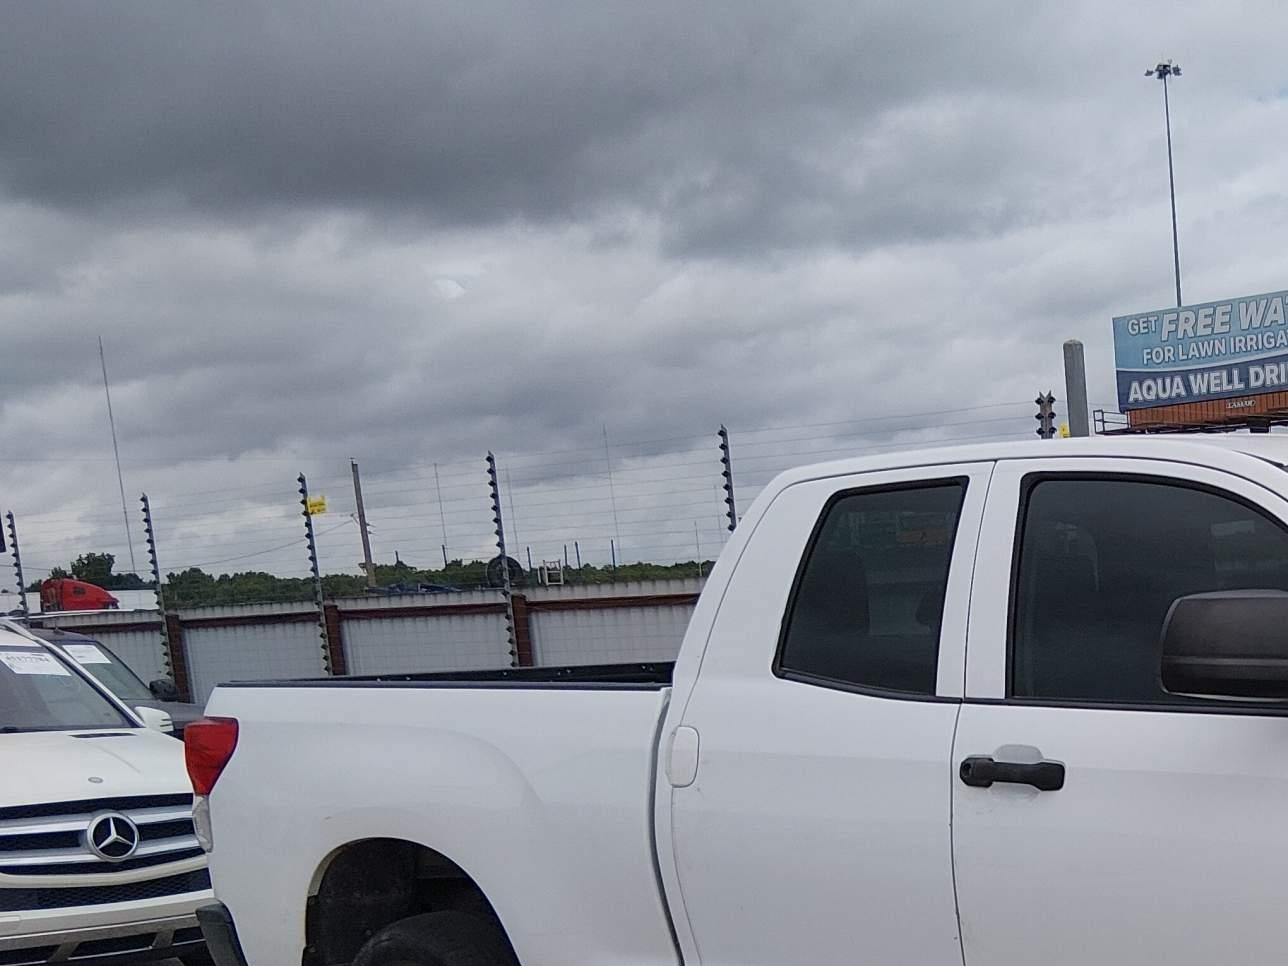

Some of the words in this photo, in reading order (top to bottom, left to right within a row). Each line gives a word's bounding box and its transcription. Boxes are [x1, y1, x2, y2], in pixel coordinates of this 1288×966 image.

[1127, 317, 1158, 336] GET
[1161, 303, 1232, 341] FREE
[1143, 346, 1176, 365] FOR
[1178, 337, 1227, 361] LAWN
[1127, 377, 1187, 404] AQUA
[1188, 369, 1245, 396] WELL
